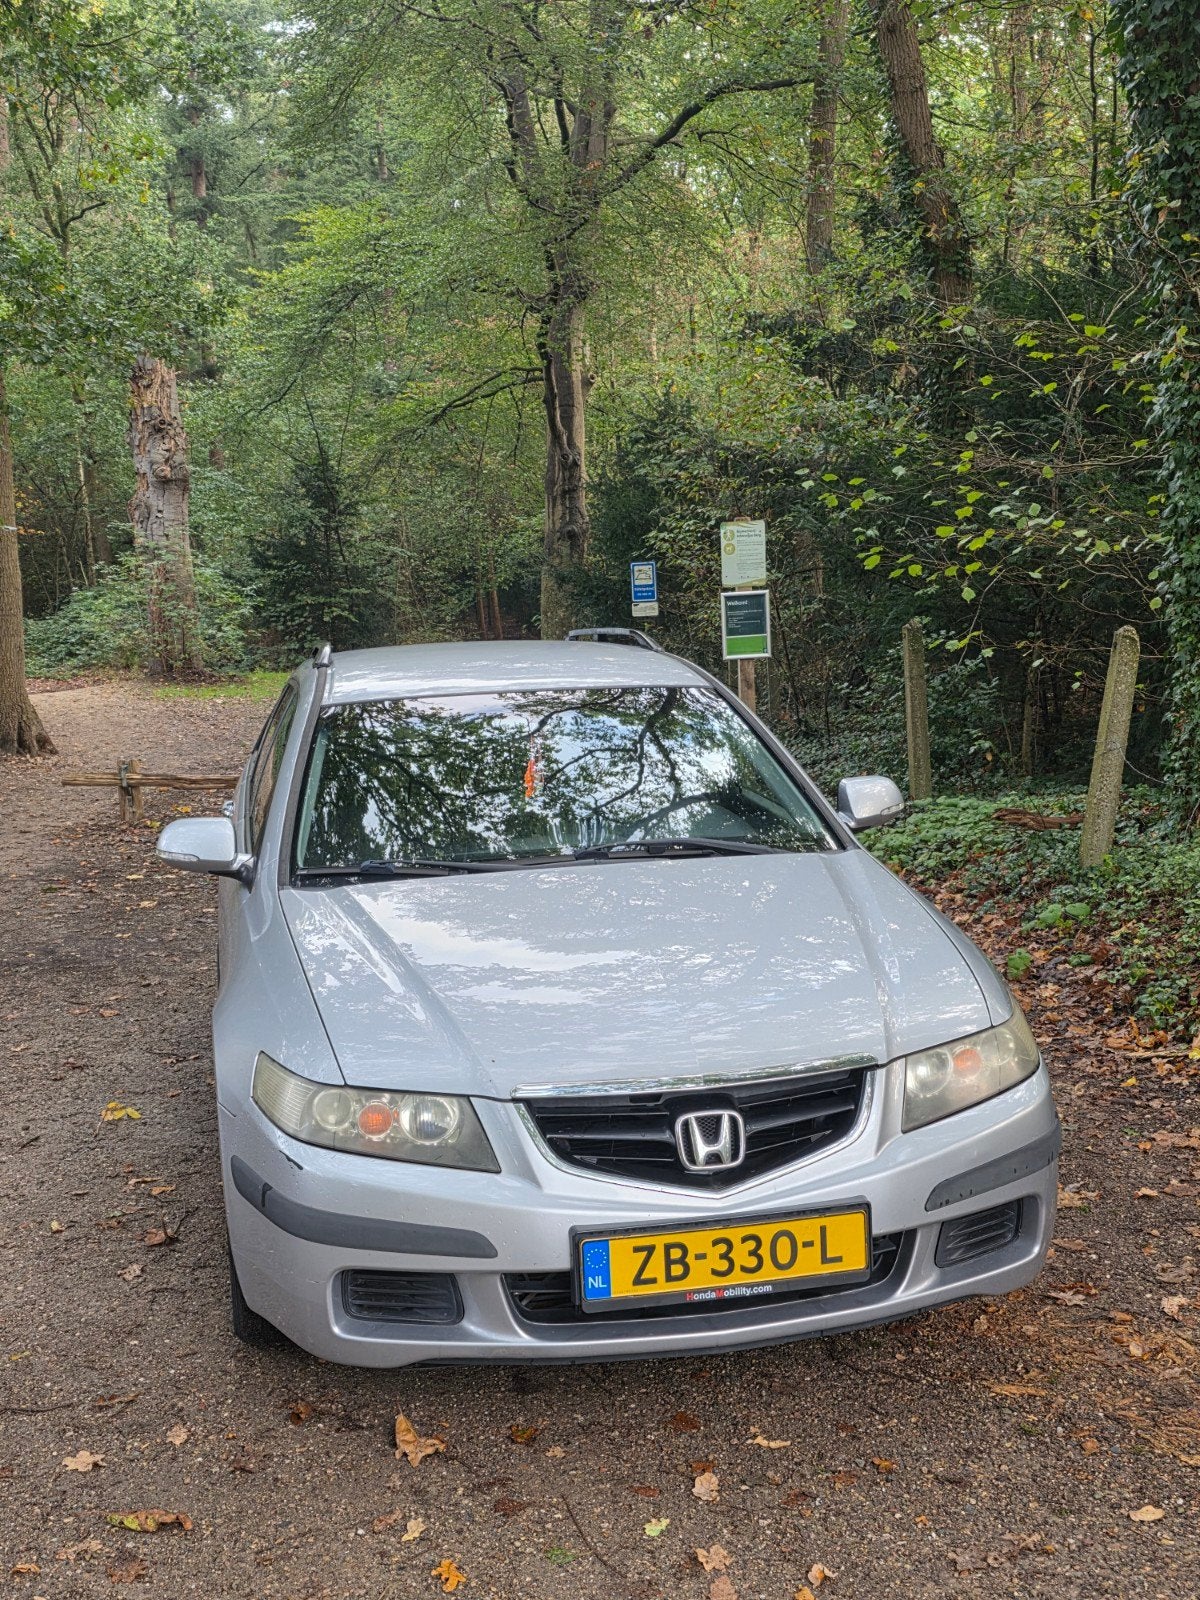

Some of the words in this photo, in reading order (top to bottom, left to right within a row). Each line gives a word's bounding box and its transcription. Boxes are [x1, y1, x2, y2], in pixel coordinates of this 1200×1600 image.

[632, 1225, 843, 1286] ZB-330-L
[588, 1275, 607, 1289] NL
[686, 1284, 772, 1301] HondaMobility.com
